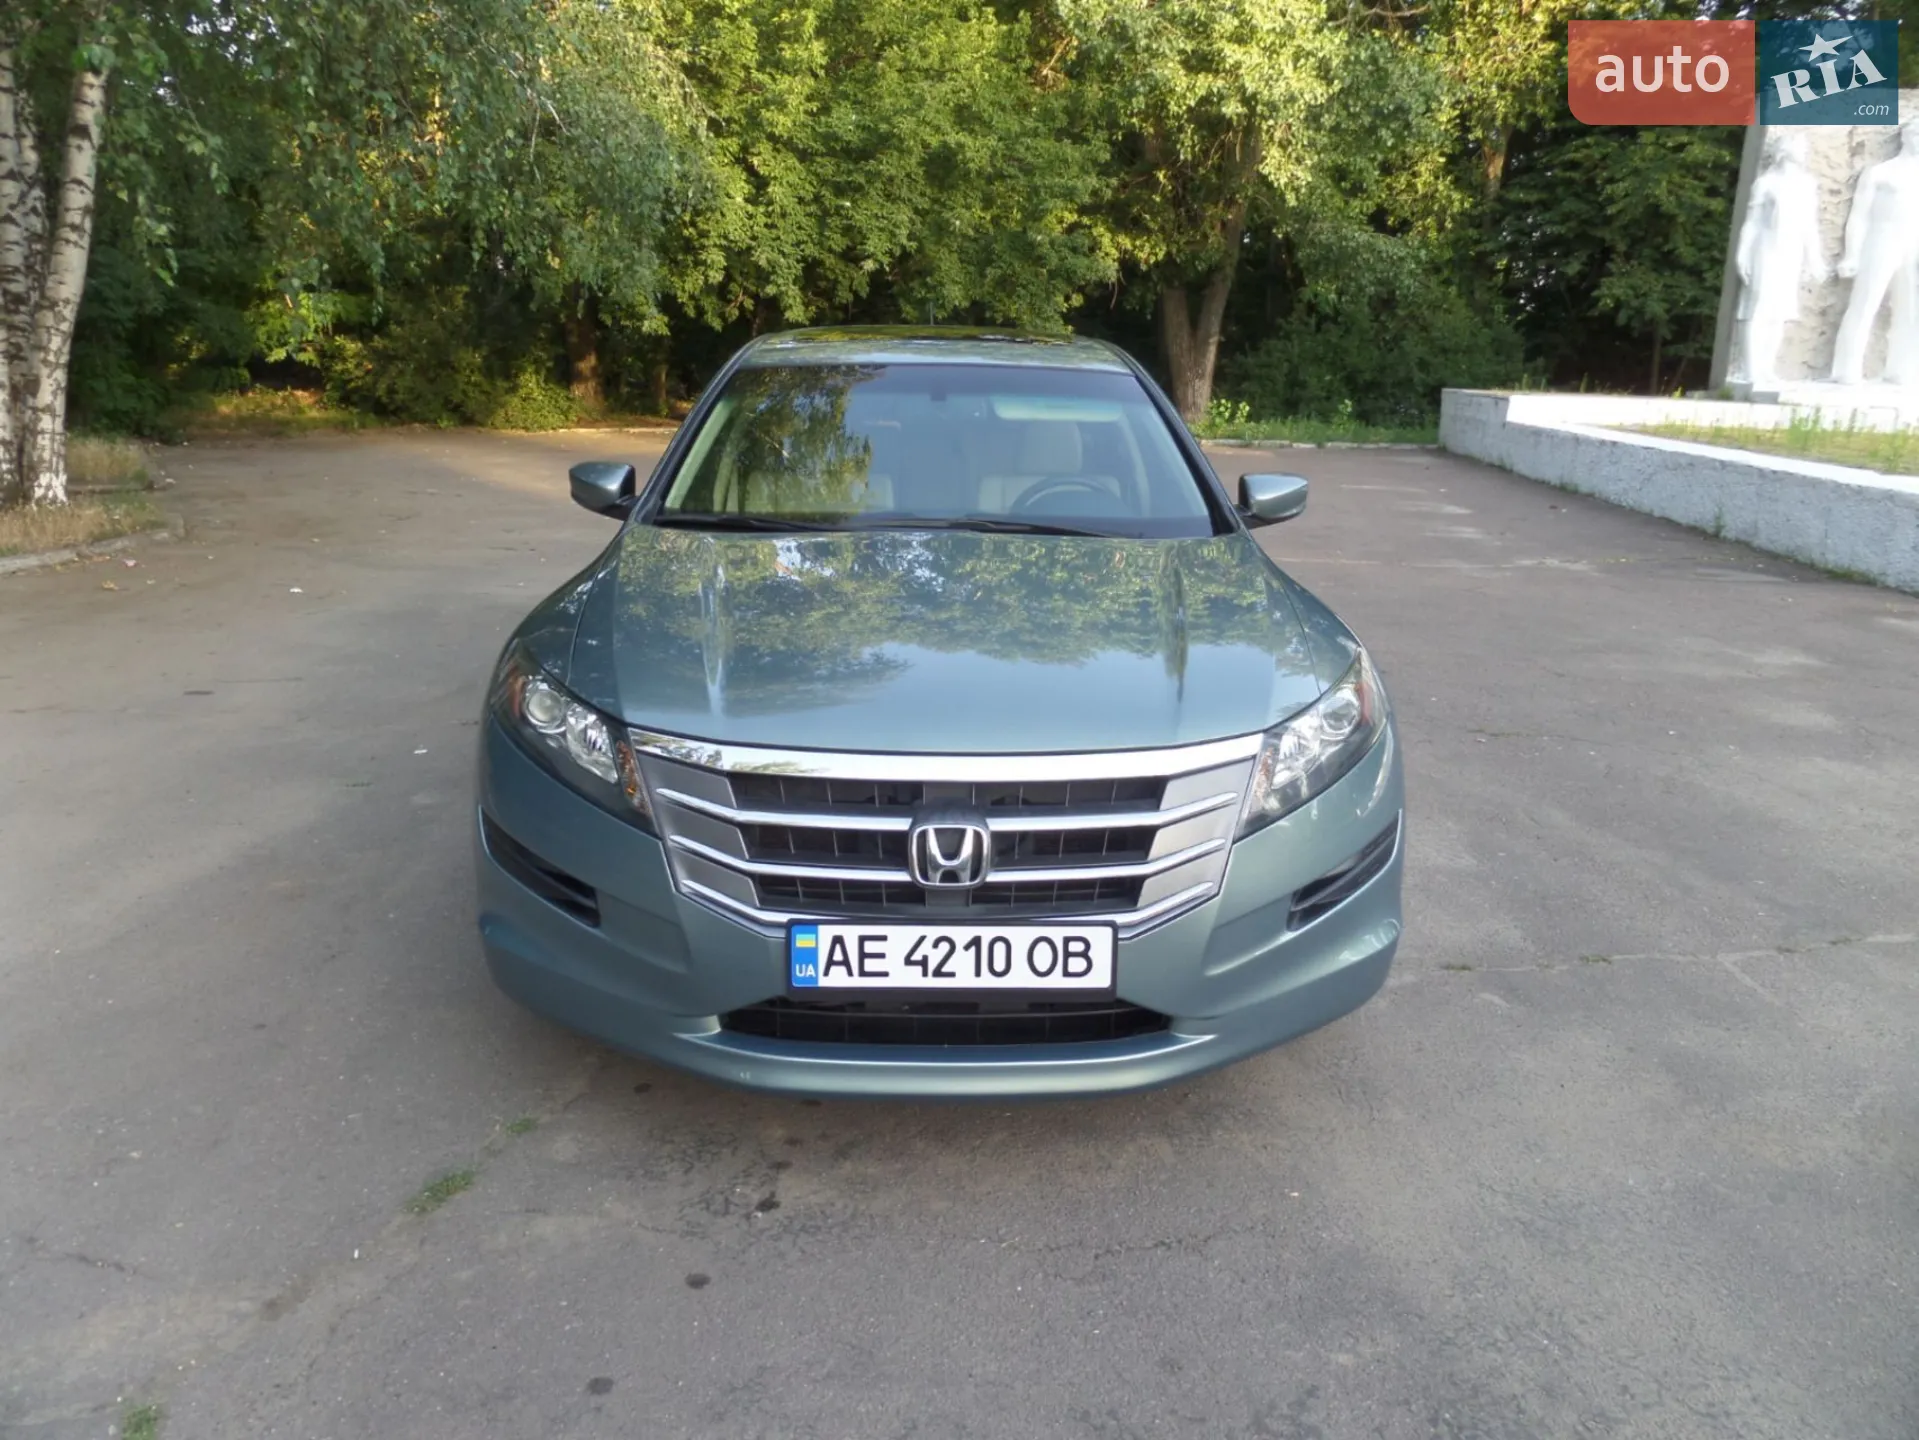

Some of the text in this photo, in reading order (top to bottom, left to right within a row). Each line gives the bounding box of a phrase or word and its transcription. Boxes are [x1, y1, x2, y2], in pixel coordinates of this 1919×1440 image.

[822, 934, 1093, 978] AE 4210 OB
[795, 964, 816, 978] UA
